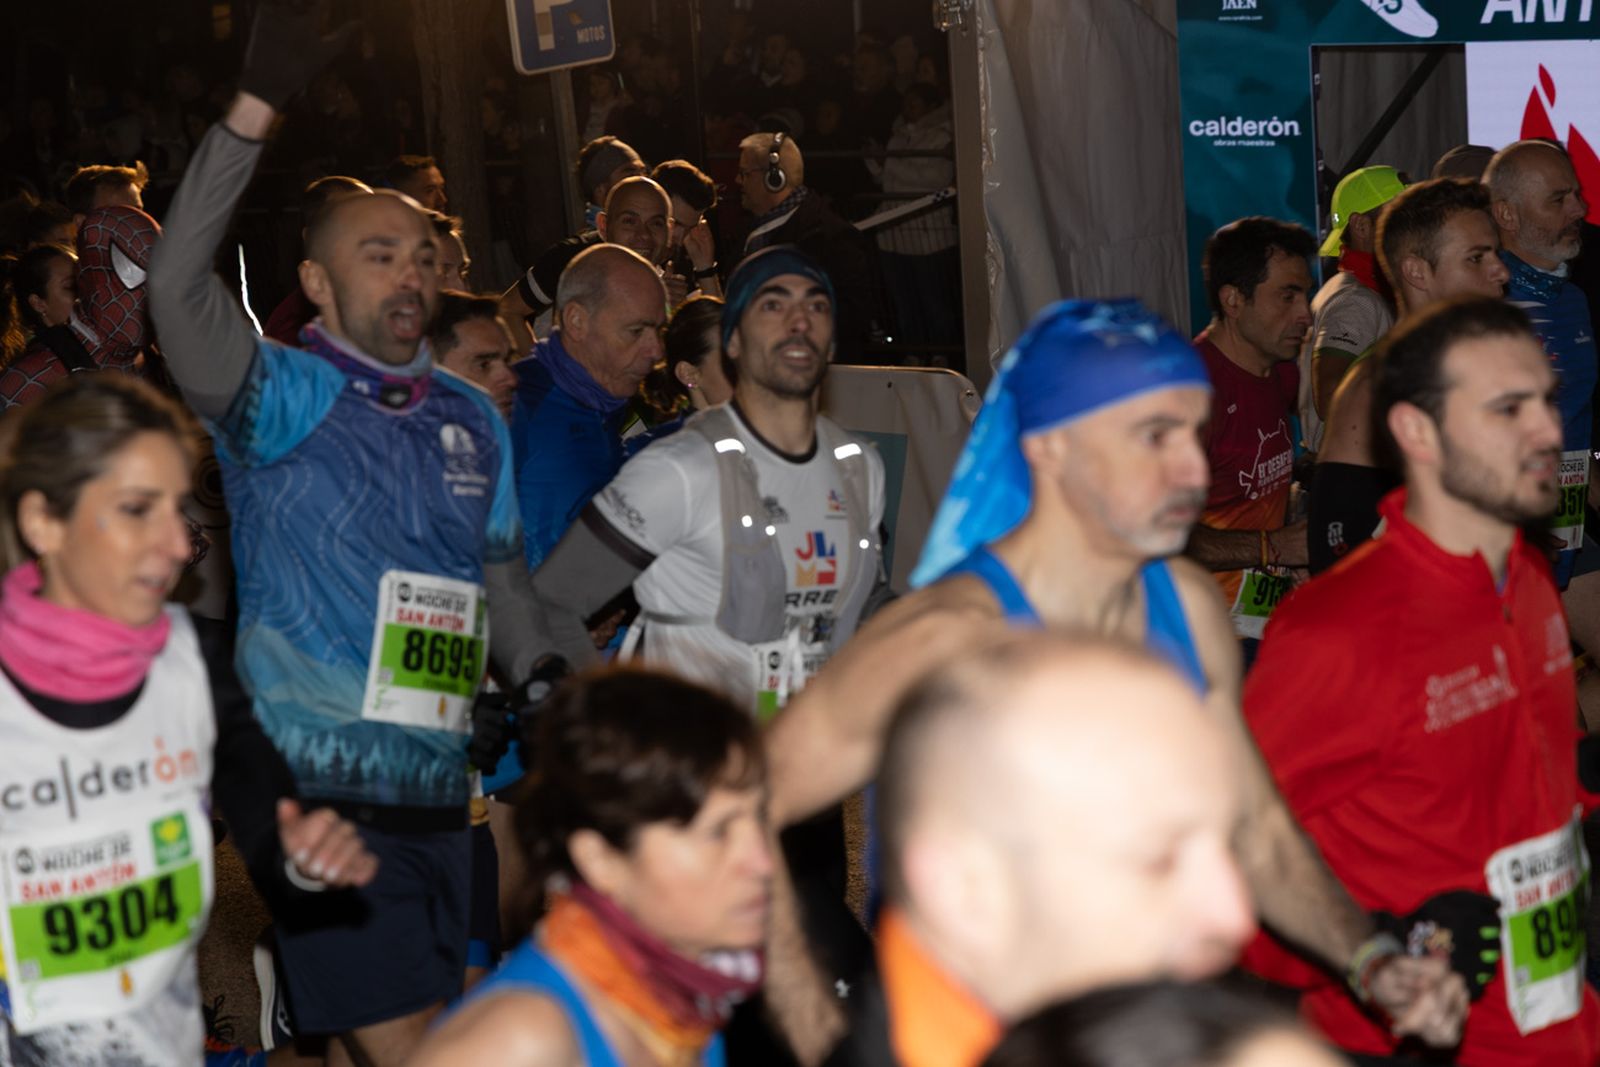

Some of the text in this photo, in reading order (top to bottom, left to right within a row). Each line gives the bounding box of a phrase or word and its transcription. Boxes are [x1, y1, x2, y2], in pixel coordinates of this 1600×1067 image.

[577, 25, 605, 43] MOTOS
[1189, 116, 1301, 136] calderón
[1213, 139, 1276, 147] obras maestras
[396, 607, 424, 624] SAN
[403, 629, 475, 681] 8695
[21, 879, 61, 901] SAN
[43, 874, 180, 957] 9304
[1531, 897, 1577, 960] 89
